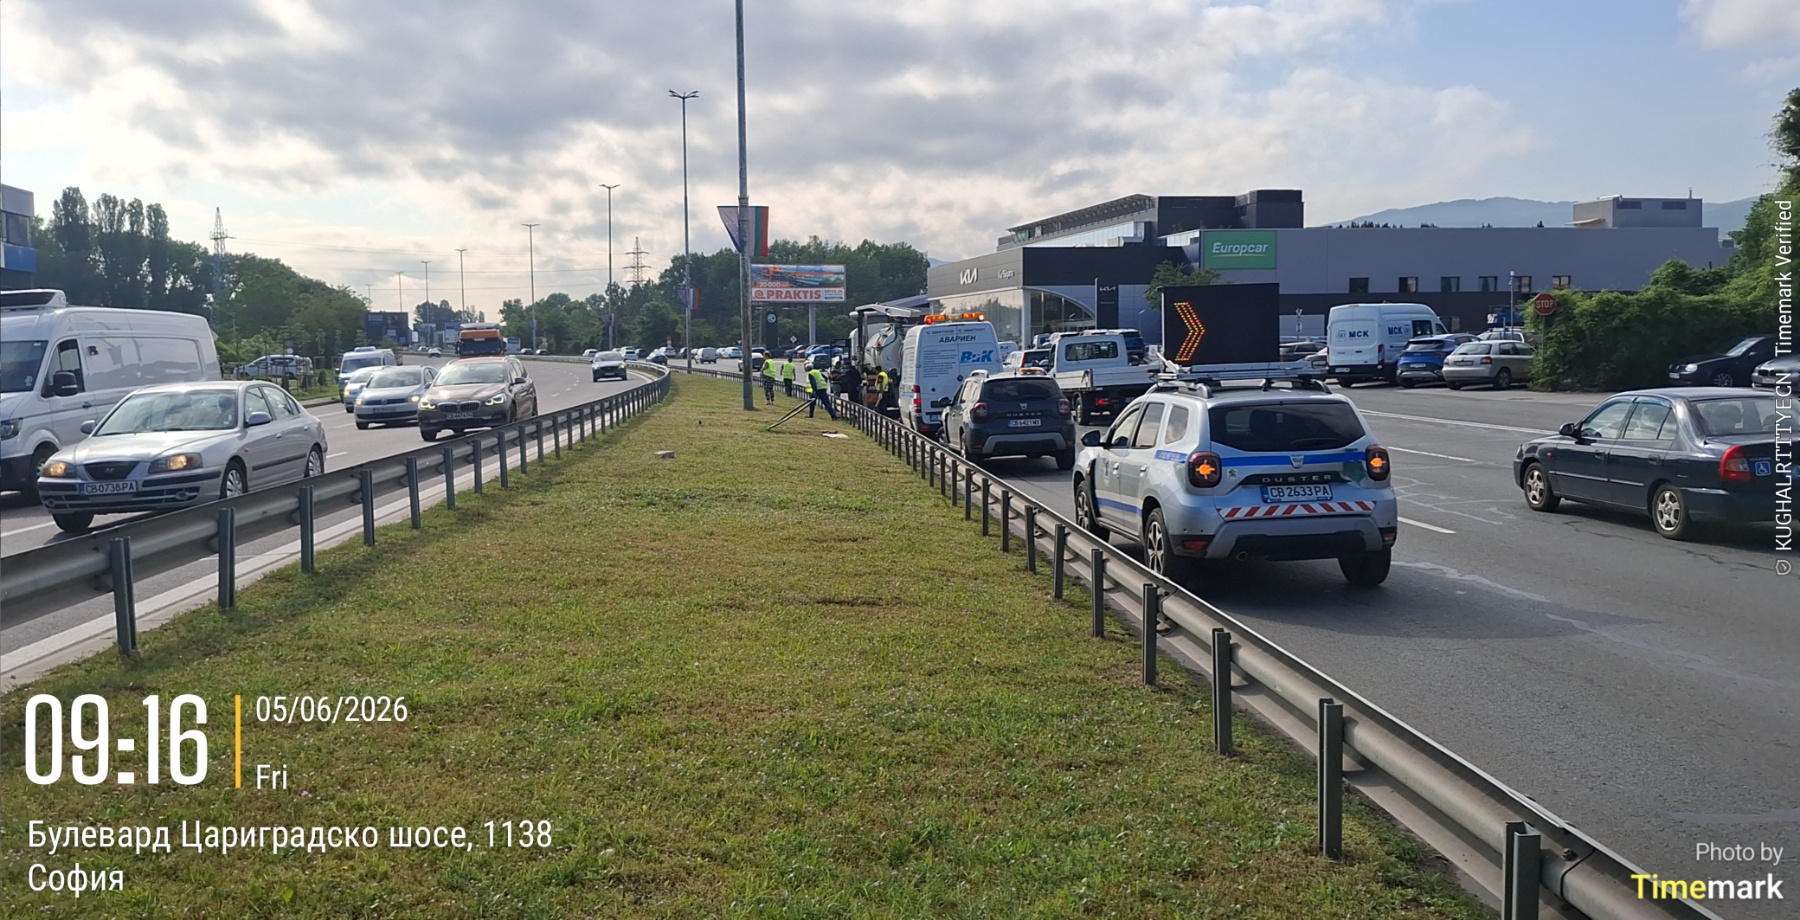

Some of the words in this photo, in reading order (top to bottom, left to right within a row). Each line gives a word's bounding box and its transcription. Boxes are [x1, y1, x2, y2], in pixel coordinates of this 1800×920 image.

[1212, 242, 1269, 256] Europcar
[960, 267, 978, 285] KIA
[766, 289, 822, 299] PRAKTIS
[1536, 300, 1555, 309] STOP
[1349, 330, 1369, 338] МСК
[1388, 326, 1403, 335] МСК
[939, 335, 976, 344] АВАРИЕН
[1262, 474, 1332, 483] DUSTER
[85, 484, 98, 494] CB
[99, 483, 120, 493] 0738
[121, 482, 135, 492] PA
[1270, 487, 1285, 498] CB
[1287, 486, 1313, 498] 2633
[1315, 486, 1330, 497] PA
